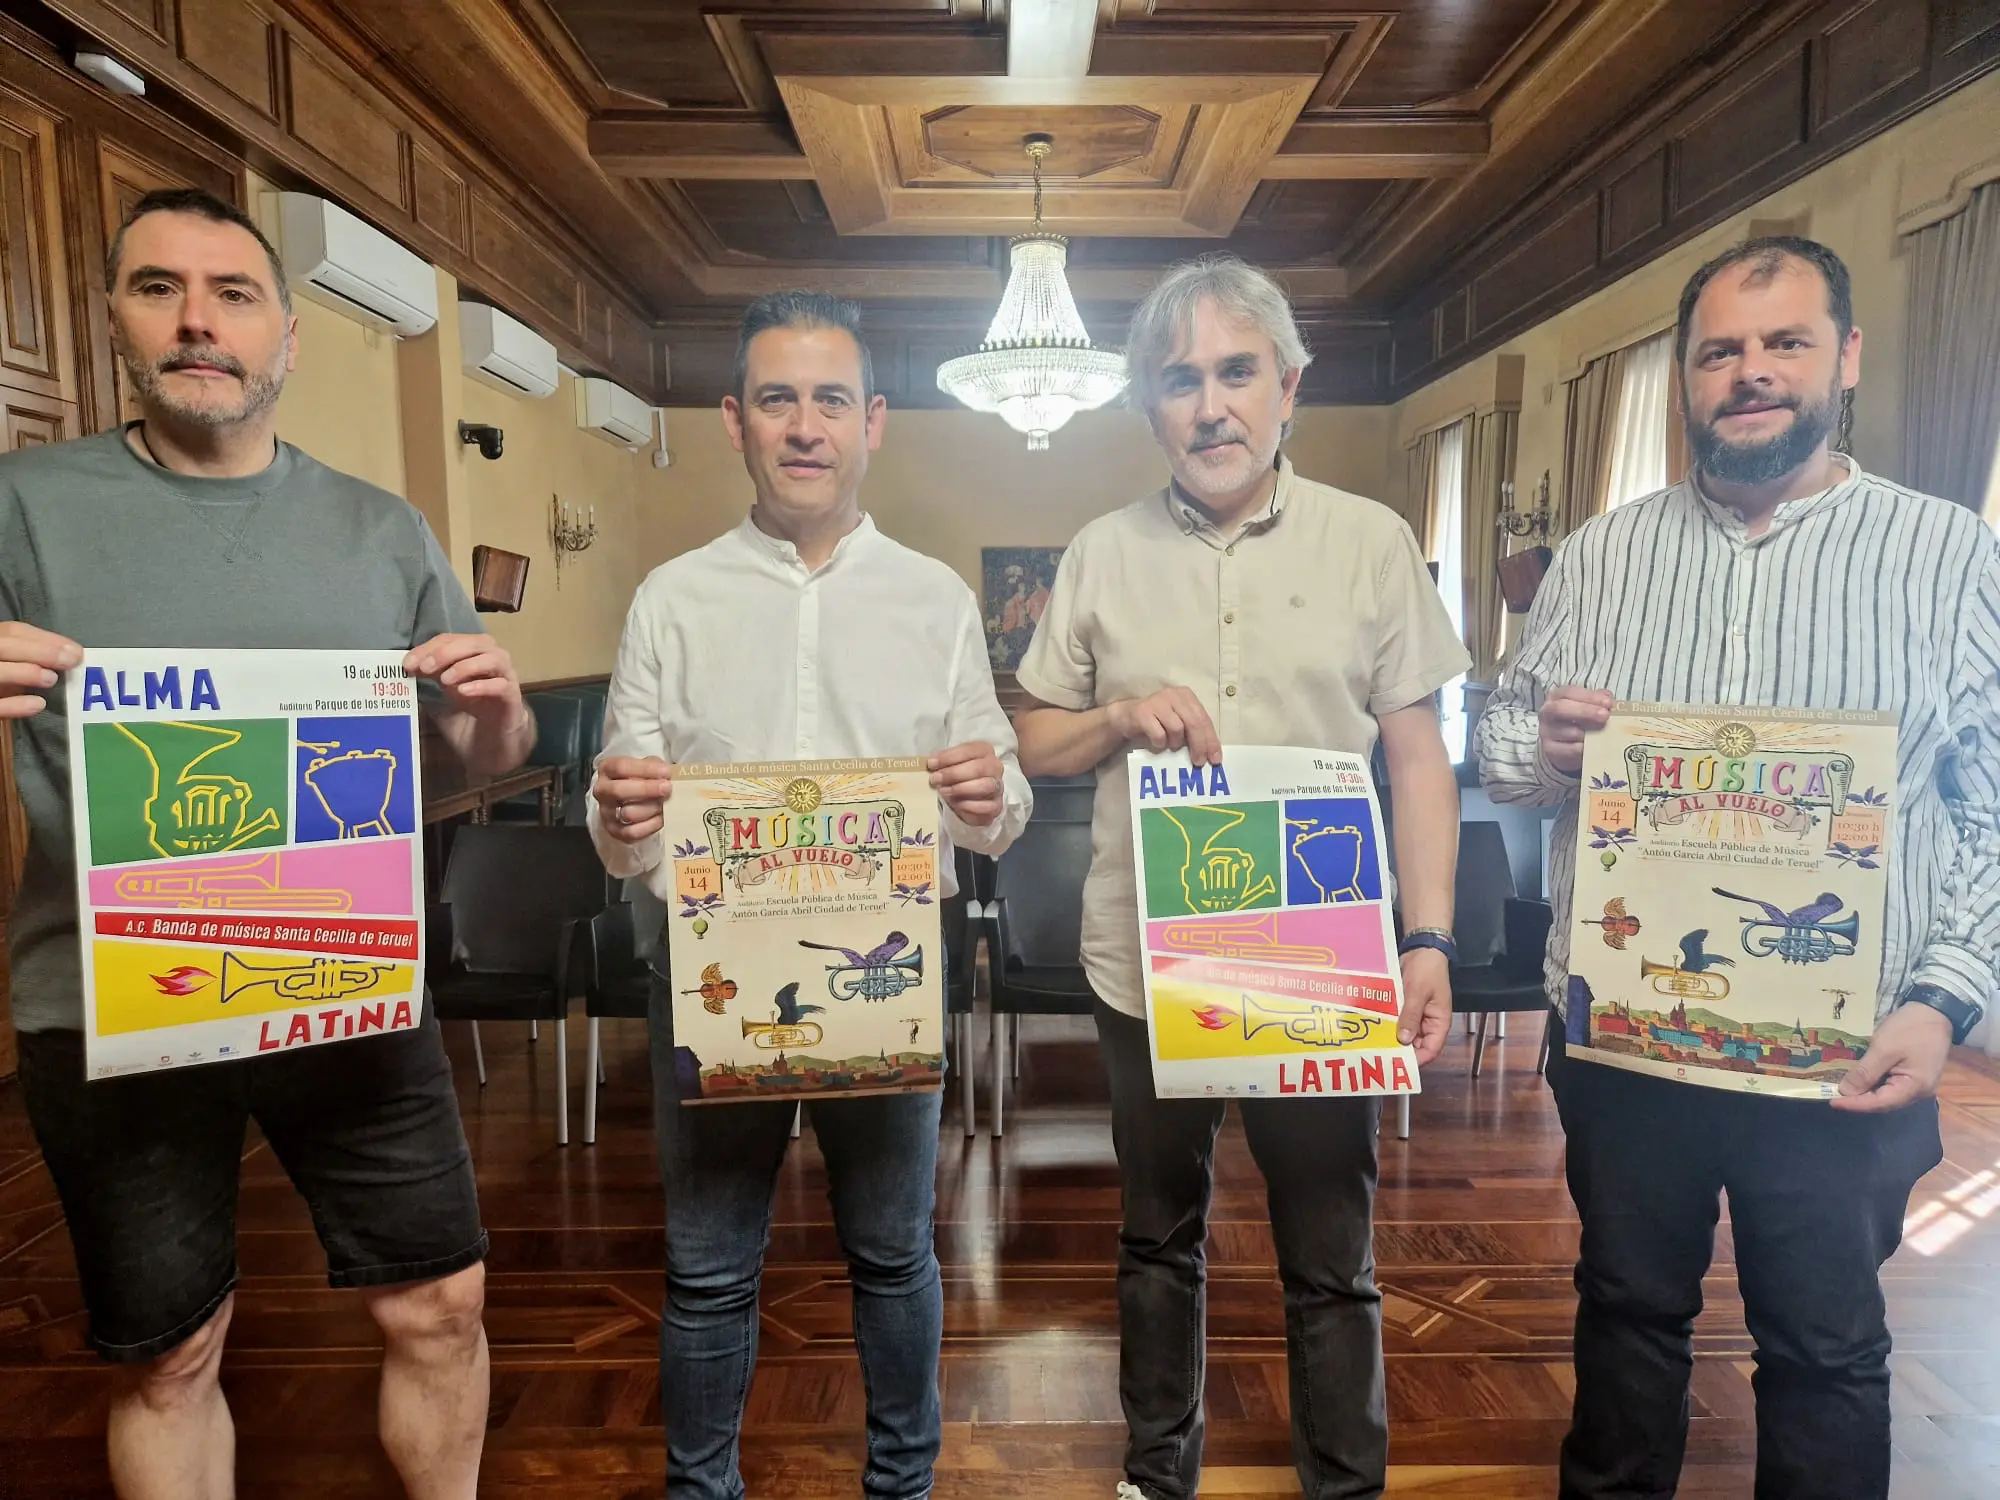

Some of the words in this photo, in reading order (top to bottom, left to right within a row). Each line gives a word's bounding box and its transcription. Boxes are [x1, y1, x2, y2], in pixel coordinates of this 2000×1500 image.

[343, 665, 356, 679] 19
[360, 668, 371, 679] de
[82, 666, 220, 711] ALMA
[372, 682, 410, 696] 19:30h
[280, 703, 312, 711] Auditorio
[316, 700, 348, 711] Parque
[351, 700, 362, 710] de
[365, 699, 378, 709] los
[381, 698, 411, 709] Fueros
[1632, 702, 1669, 714] Banda
[1672, 703, 1686, 714] de
[1688, 704, 1731, 716] música
[1734, 706, 1768, 718] Santa
[1772, 707, 1814, 720] Cecilia
[1817, 709, 1833, 720] de
[1837, 709, 1878, 722] Teruel
[678, 765, 699, 776] A.C.
[705, 764, 738, 776] Banda
[742, 763, 756, 774] de
[759, 761, 797, 774] música
[799, 759, 830, 772] Santa
[832, 758, 868, 771] Cecilia
[870, 758, 884, 769] de
[887, 757, 920, 769] Teruel
[1313, 760, 1324, 770] 19
[1325, 762, 1334, 770] de
[1336, 760, 1360, 771] JUNIO
[1140, 764, 1230, 800] ALMA
[1652, 756, 1830, 798] MÚSICA
[1297, 785, 1320, 794] Parque
[1323, 785, 1331, 793] de
[1333, 784, 1344, 792] los
[1598, 798, 1626, 808] Junio
[1680, 798, 1704, 813] AL
[1715, 794, 1786, 817] VUELO
[1601, 810, 1621, 825] 14
[731, 812, 888, 850] MÚSICA
[1682, 840, 1718, 849] Escuela
[1720, 842, 1756, 853] Pública
[1759, 844, 1771, 853] de
[1774, 846, 1810, 856] Música
[760, 852, 783, 872] AL
[792, 848, 854, 868] VUELO
[1673, 850, 1704, 860] García
[1706, 852, 1731, 862] Abril
[1733, 854, 1768, 865] Ciudad
[1771, 856, 1783, 866] de
[684, 866, 711, 876] Junio
[688, 876, 708, 890] 14
[766, 897, 798, 905] Escuela
[801, 895, 832, 904] Pública
[835, 894, 844, 902] de
[847, 893, 877, 901] Música
[760, 908, 788, 917] García
[790, 906, 812, 916] Abril
[814, 904, 844, 914] Ciudad
[846, 903, 856, 912] de
[126, 920, 147, 934] A.C.
[152, 919, 197, 936] Banda
[200, 922, 216, 937] de
[222, 922, 270, 939] música
[274, 926, 310, 941] Santa
[314, 928, 356, 944] Cecilia
[360, 930, 374, 945] de
[378, 931, 413, 947] Teruel
[1238, 972, 1275, 986] música
[1278, 976, 1306, 990] Santa
[1309, 979, 1344, 996] Cecilia
[1346, 983, 1359, 997] de
[1362, 985, 1392, 1003] Teruel
[258, 1001, 412, 1052] LATINA
[1279, 1056, 1412, 1093] LATINA
